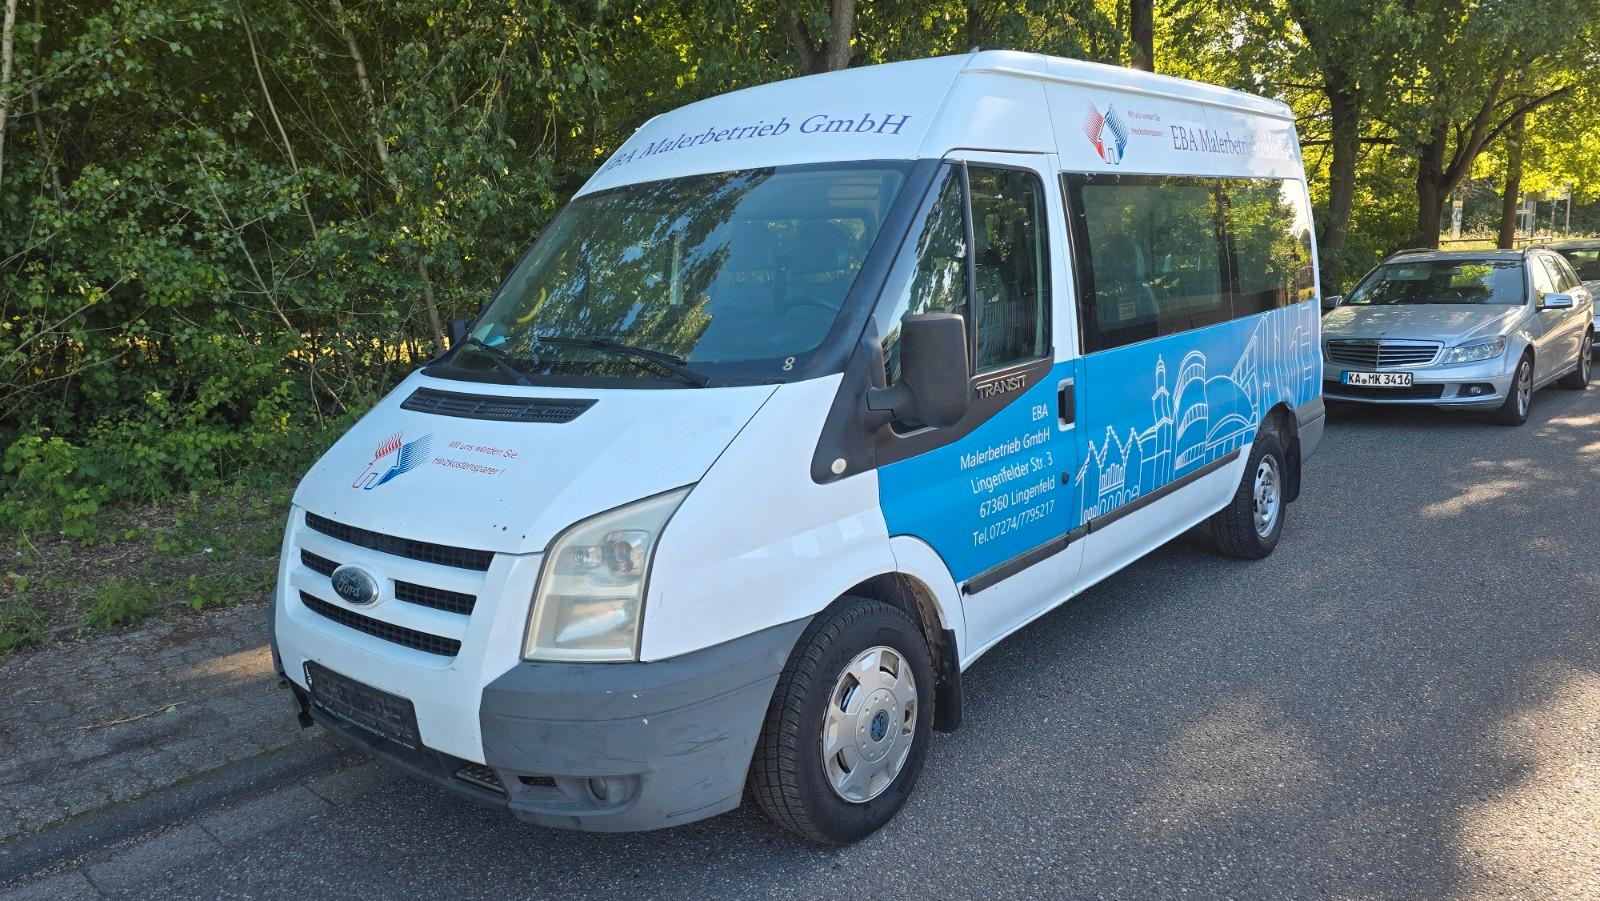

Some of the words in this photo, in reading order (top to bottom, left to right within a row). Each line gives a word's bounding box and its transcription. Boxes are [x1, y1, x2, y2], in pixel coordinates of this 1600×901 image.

[638, 116, 790, 159] Malerbetrieb
[799, 113, 912, 135] GmbH
[1170, 125, 1198, 152] EBA
[782, 356, 796, 371] 8
[976, 375, 1027, 400] TRANSIT
[1349, 374, 1360, 384] KA
[1369, 374, 1381, 385] MK
[1384, 374, 1411, 386] 3416
[1032, 403, 1049, 421] EBA
[960, 437, 1021, 470] Malerbetrieb
[1023, 427, 1050, 448] GmbH
[971, 462, 1029, 494] Lingenfelder
[1030, 456, 1046, 471] Str.
[1047, 451, 1053, 466] 3
[979, 494, 1009, 518] 67360
[1011, 475, 1055, 505] Lingenfeld
[337, 574, 361, 598] Ford
